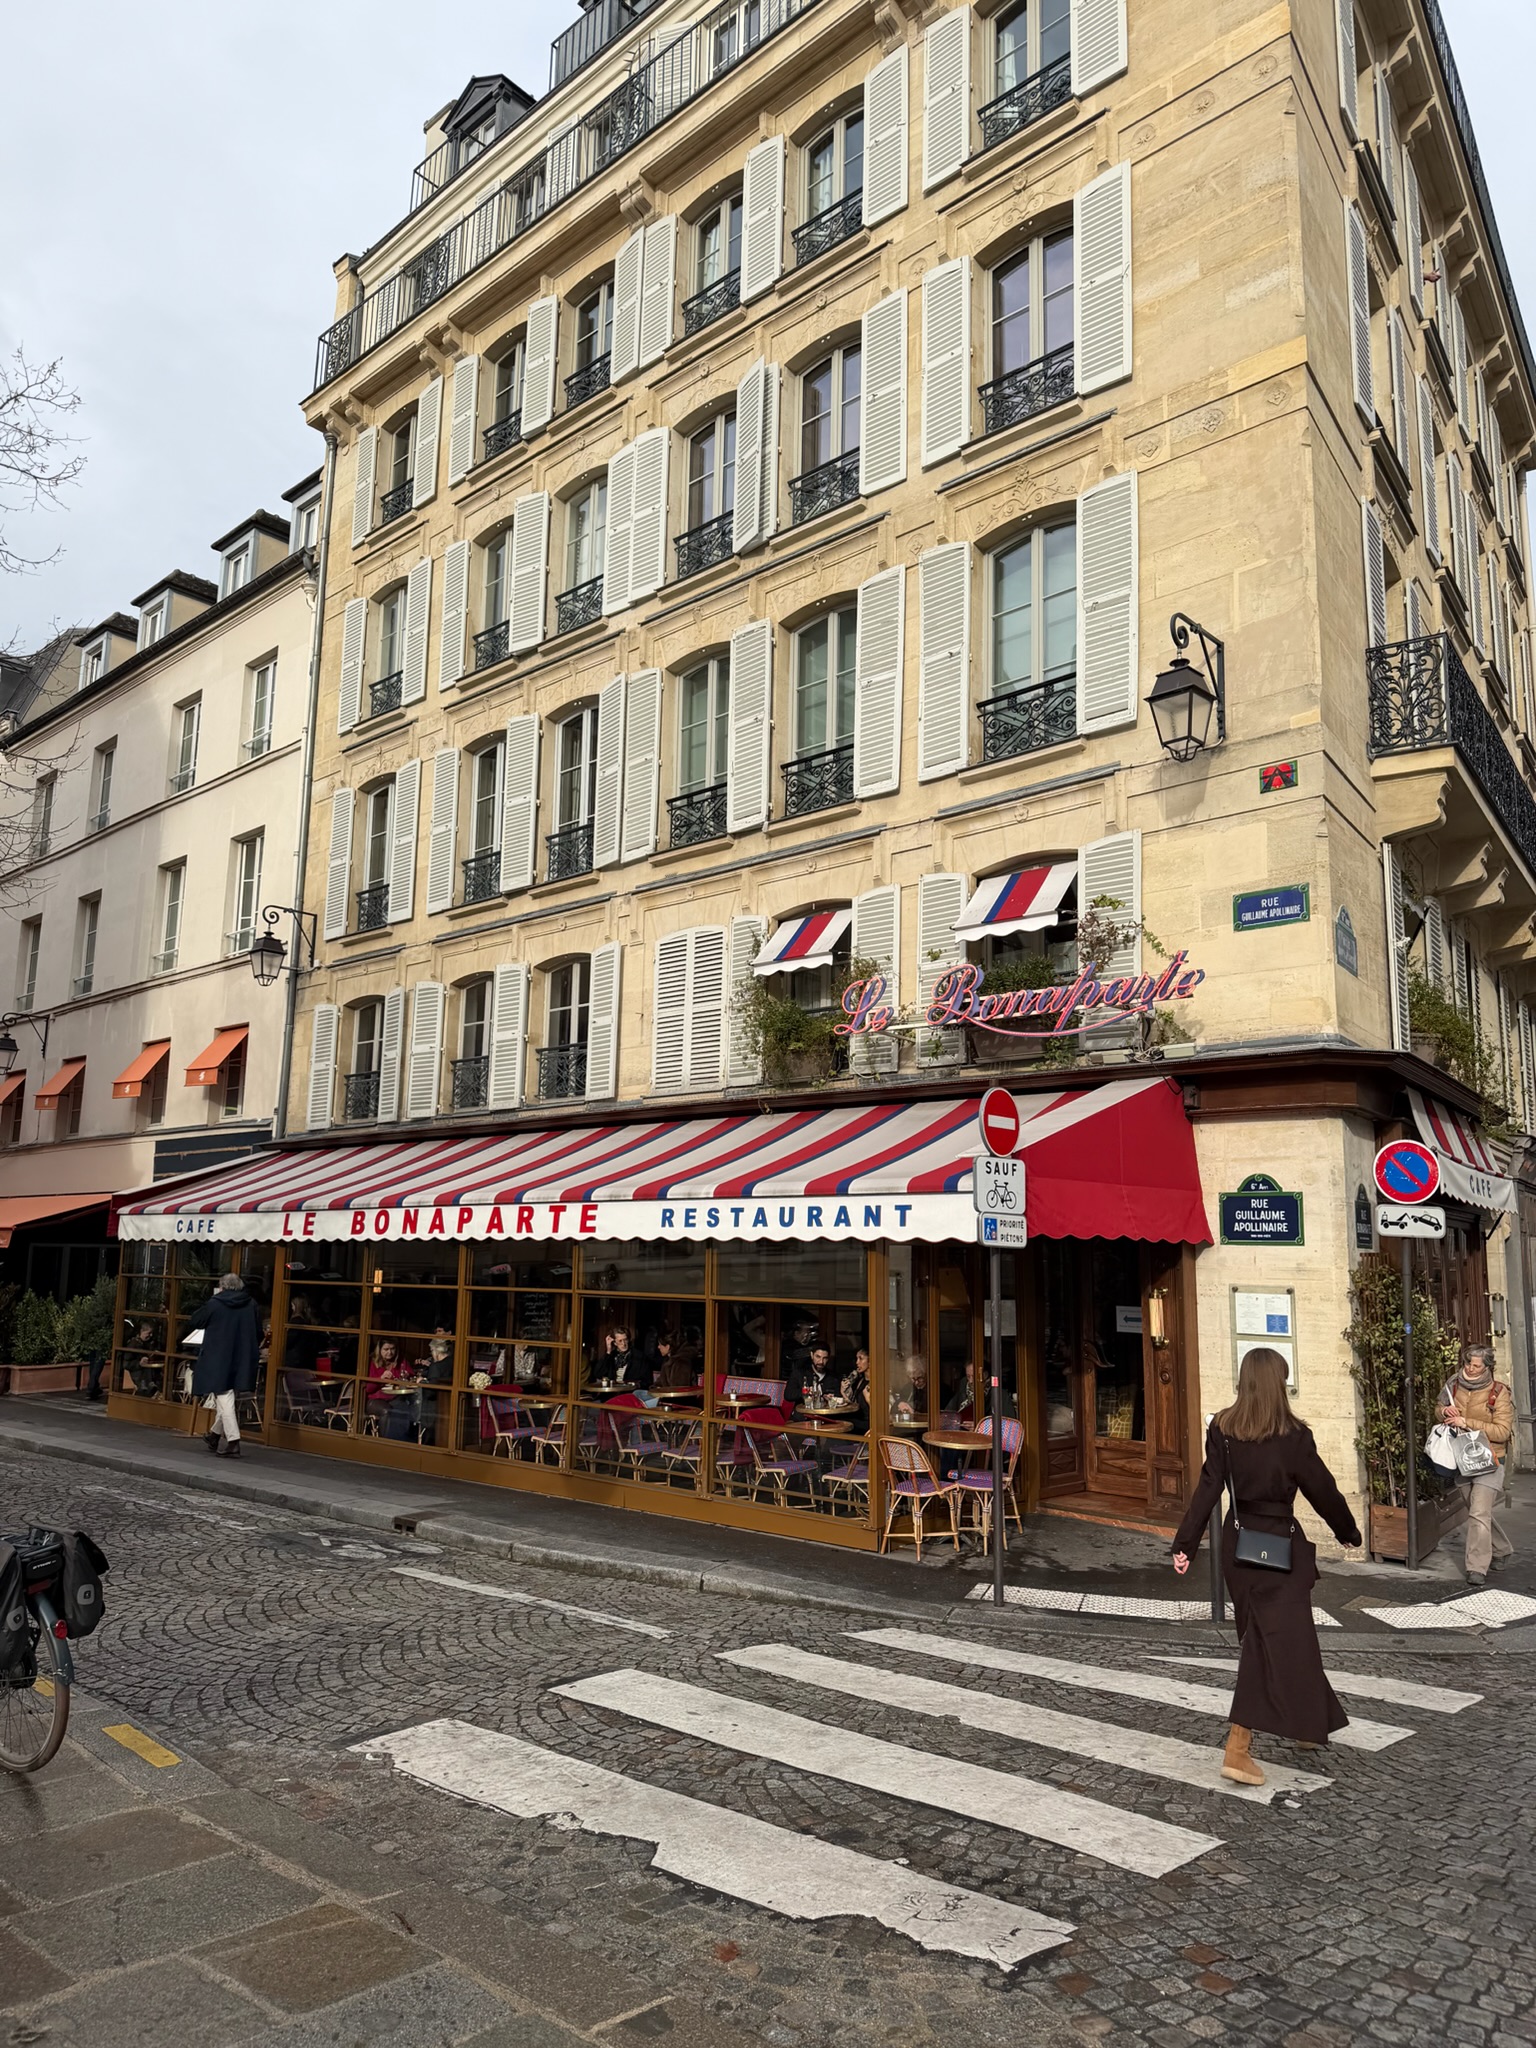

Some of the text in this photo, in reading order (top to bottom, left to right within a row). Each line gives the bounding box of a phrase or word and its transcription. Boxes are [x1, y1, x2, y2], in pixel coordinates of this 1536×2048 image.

[1261, 896, 1280, 908] RUE
[1241, 904, 1301, 921] GUILLAUME APOLLINAIRE
[833, 950, 1205, 1038] Le Bonaparte
[985, 1161, 1017, 1176] SAUF
[1469, 1174, 1492, 1199] CAFE
[1250, 1199, 1269, 1209] RUE
[176, 1204, 912, 1237] CAFE LE BONAPARTE RESTAURANT
[1235, 1210, 1286, 1221] GUILLAUME
[1233, 1222, 1289, 1233] APOLLINAIRE
[1001, 1232, 1023, 1243] PIÉTONS
